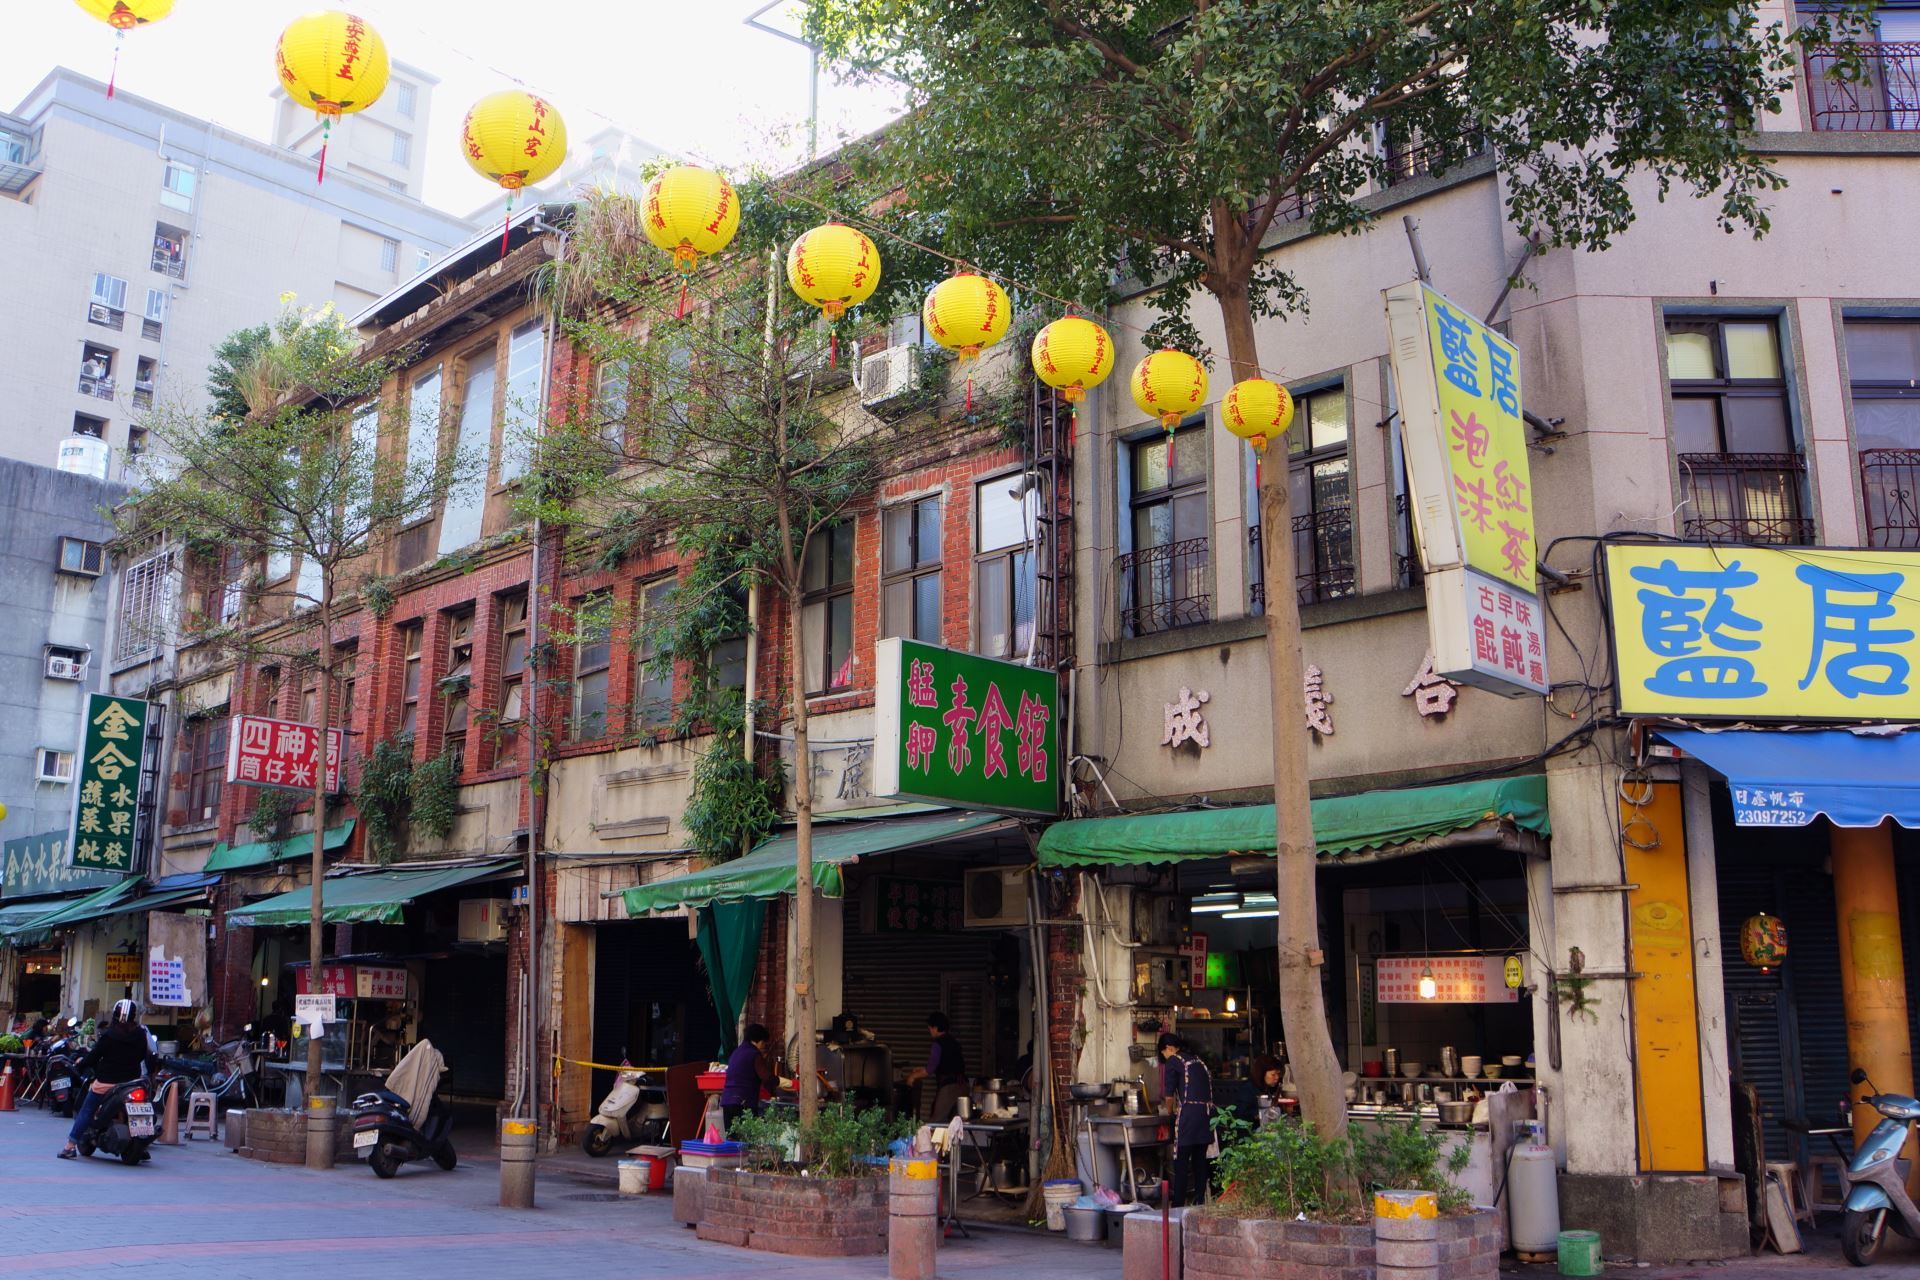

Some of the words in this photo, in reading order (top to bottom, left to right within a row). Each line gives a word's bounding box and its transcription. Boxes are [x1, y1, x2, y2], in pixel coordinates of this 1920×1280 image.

[1433, 303, 1520, 419] 藍居
[1491, 459, 1531, 582] 紅茶
[1478, 586, 1532, 627] 古早味
[1630, 559, 1916, 699] 藍居
[1473, 613, 1525, 675] 餛飩
[90, 700, 141, 780] 金合
[241, 720, 339, 766] 四神湯
[906, 657, 938, 776] 艋舺
[943, 673, 1050, 783] 素食館
[80, 780, 106, 833] 蔬菜
[108, 783, 135, 836] 水果
[1737, 809, 1806, 824] 23097252
[77, 838, 128, 867] 批發
